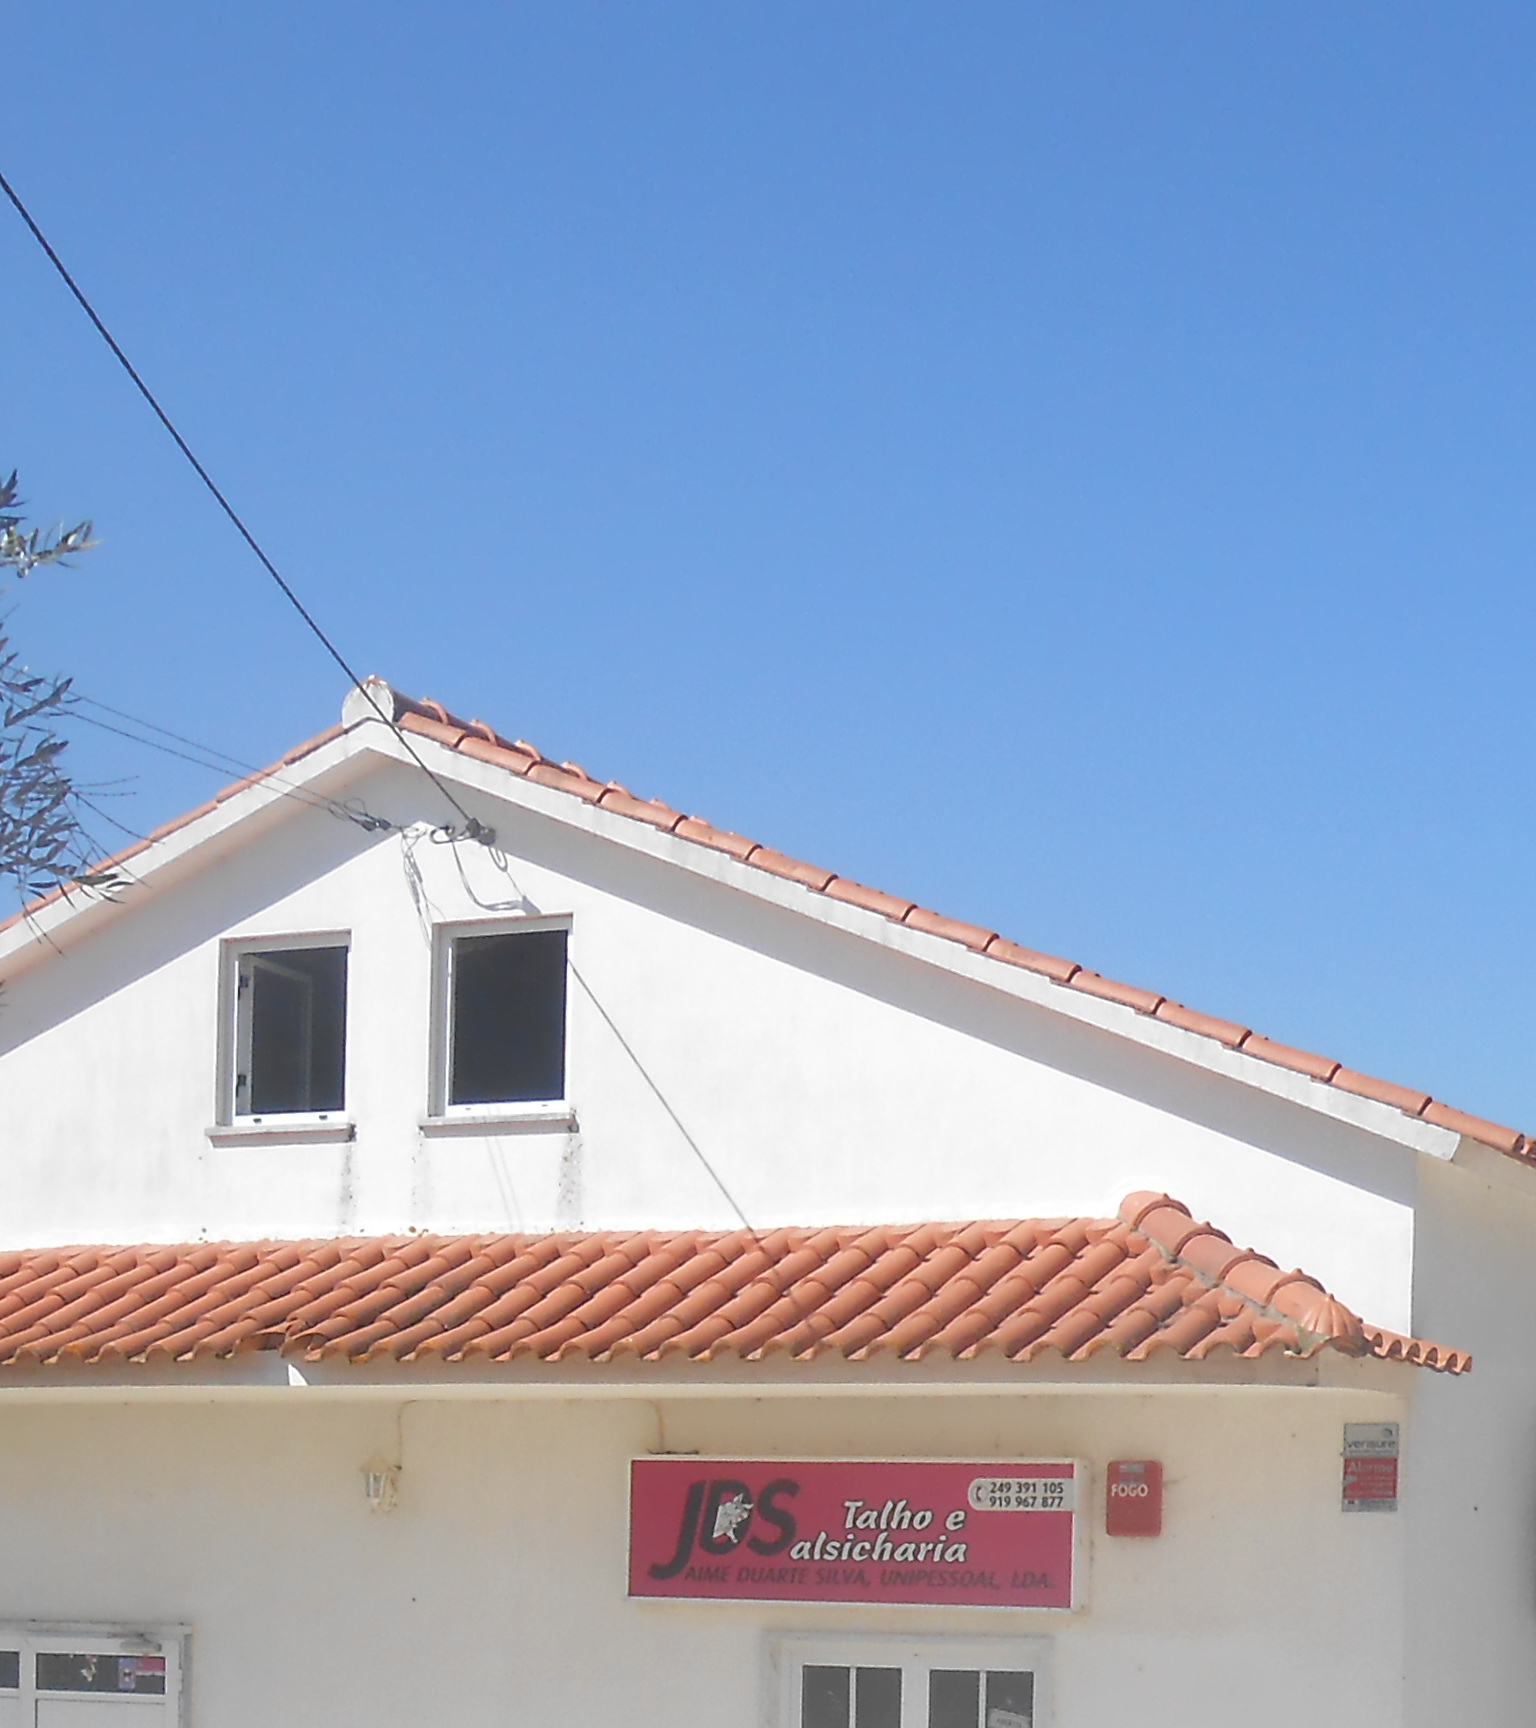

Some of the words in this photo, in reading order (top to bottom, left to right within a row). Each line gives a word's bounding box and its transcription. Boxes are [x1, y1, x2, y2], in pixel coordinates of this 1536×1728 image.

[989, 1482, 1012, 1494] 249
[1015, 1482, 1037, 1494] 391
[1043, 1482, 1064, 1494] 105
[1111, 1483, 1149, 1497] FOGO
[989, 1496, 1011, 1507] 919
[1015, 1496, 1037, 1508] 967
[1041, 1496, 1064, 1508] 877
[843, 1499, 933, 1531] Talho
[944, 1509, 966, 1532] e
[789, 1530, 968, 1563] alsicharia
[736, 1567, 808, 1585] DUARTE
[814, 1568, 871, 1588] SILVA,
